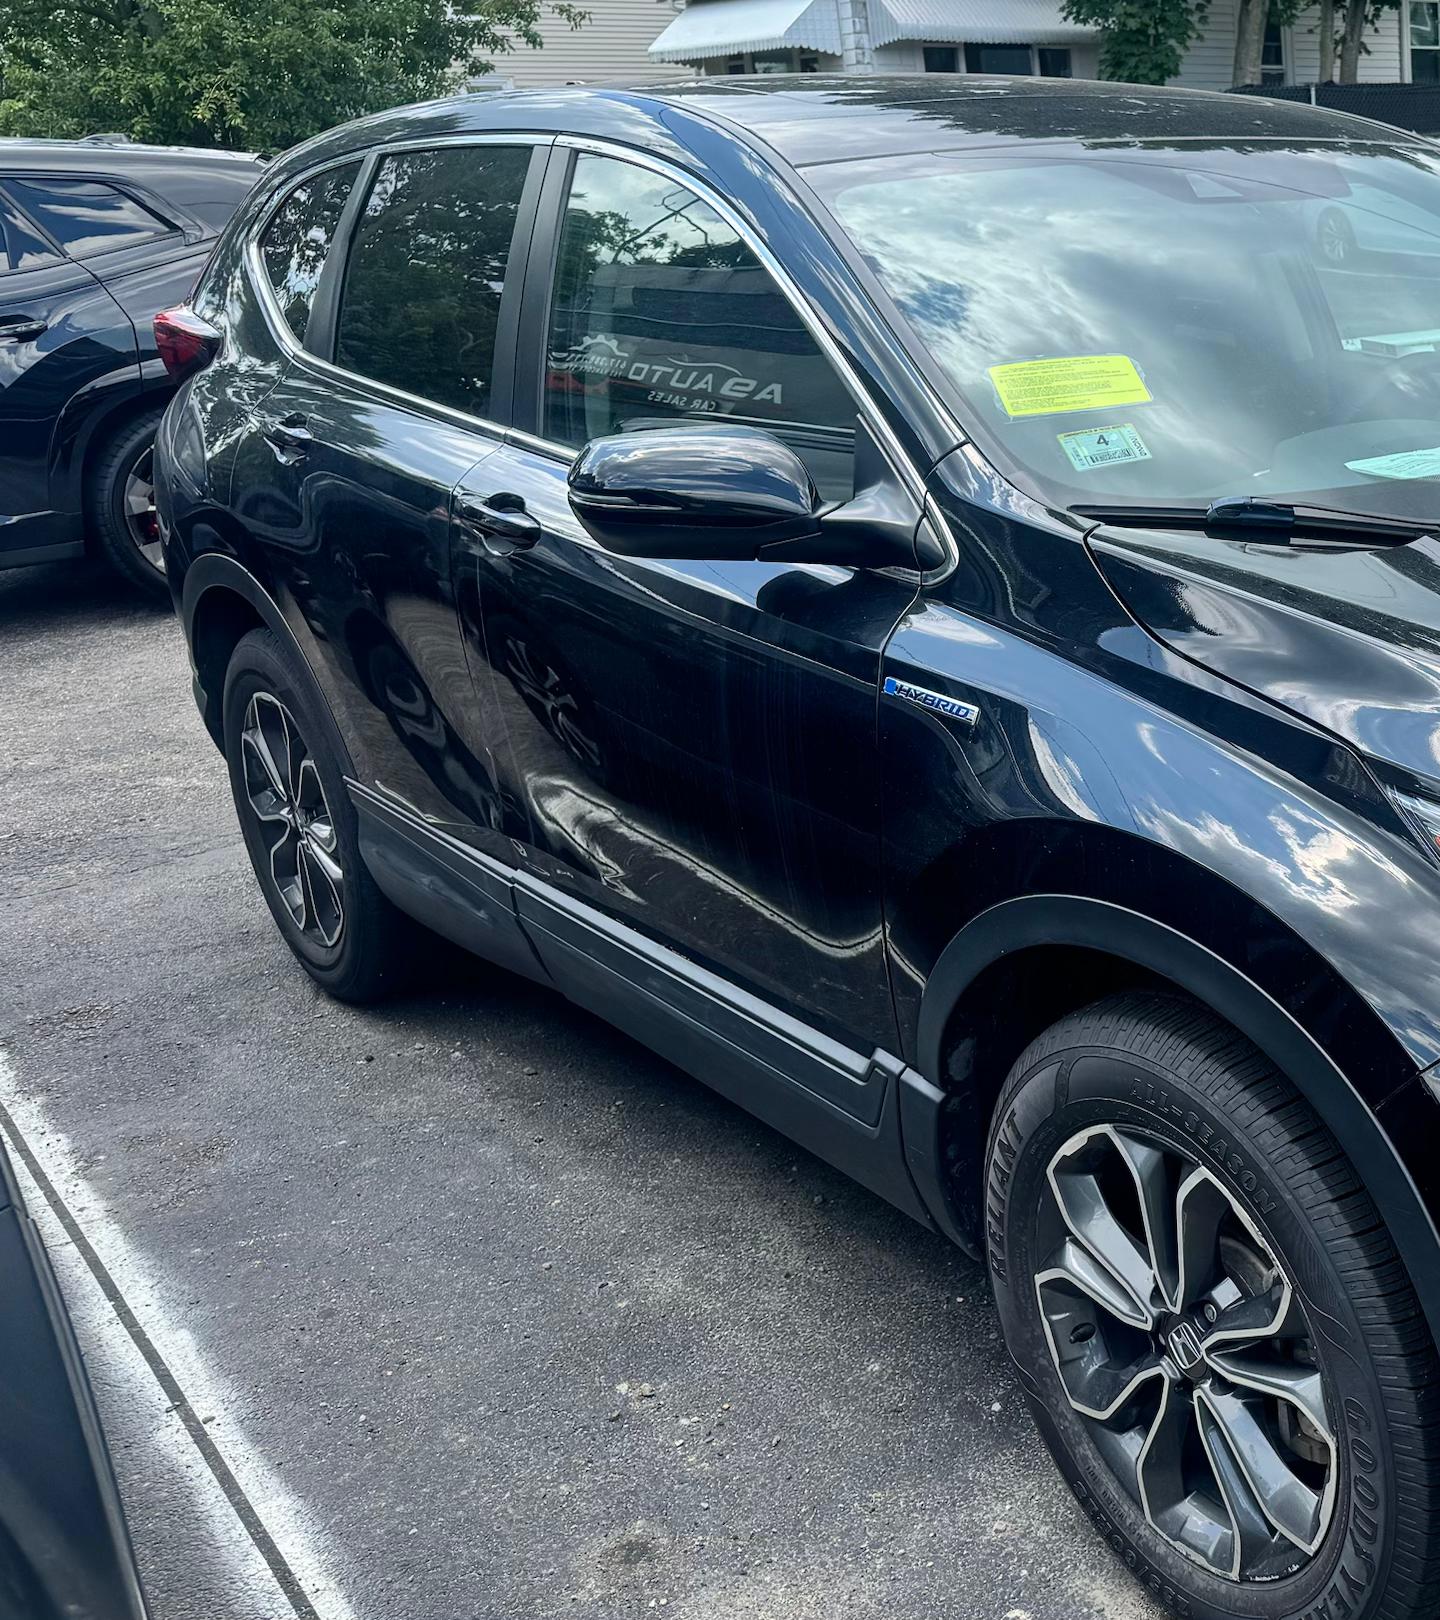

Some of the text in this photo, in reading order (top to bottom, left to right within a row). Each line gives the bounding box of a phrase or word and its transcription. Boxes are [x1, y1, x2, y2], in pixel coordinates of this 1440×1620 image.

[1097, 434, 1110, 446] 4
[895, 683, 970, 720] HYBRID
[987, 1107, 1025, 1288] RELIANT
[1298, 1396, 1379, 1620] GOODYE
